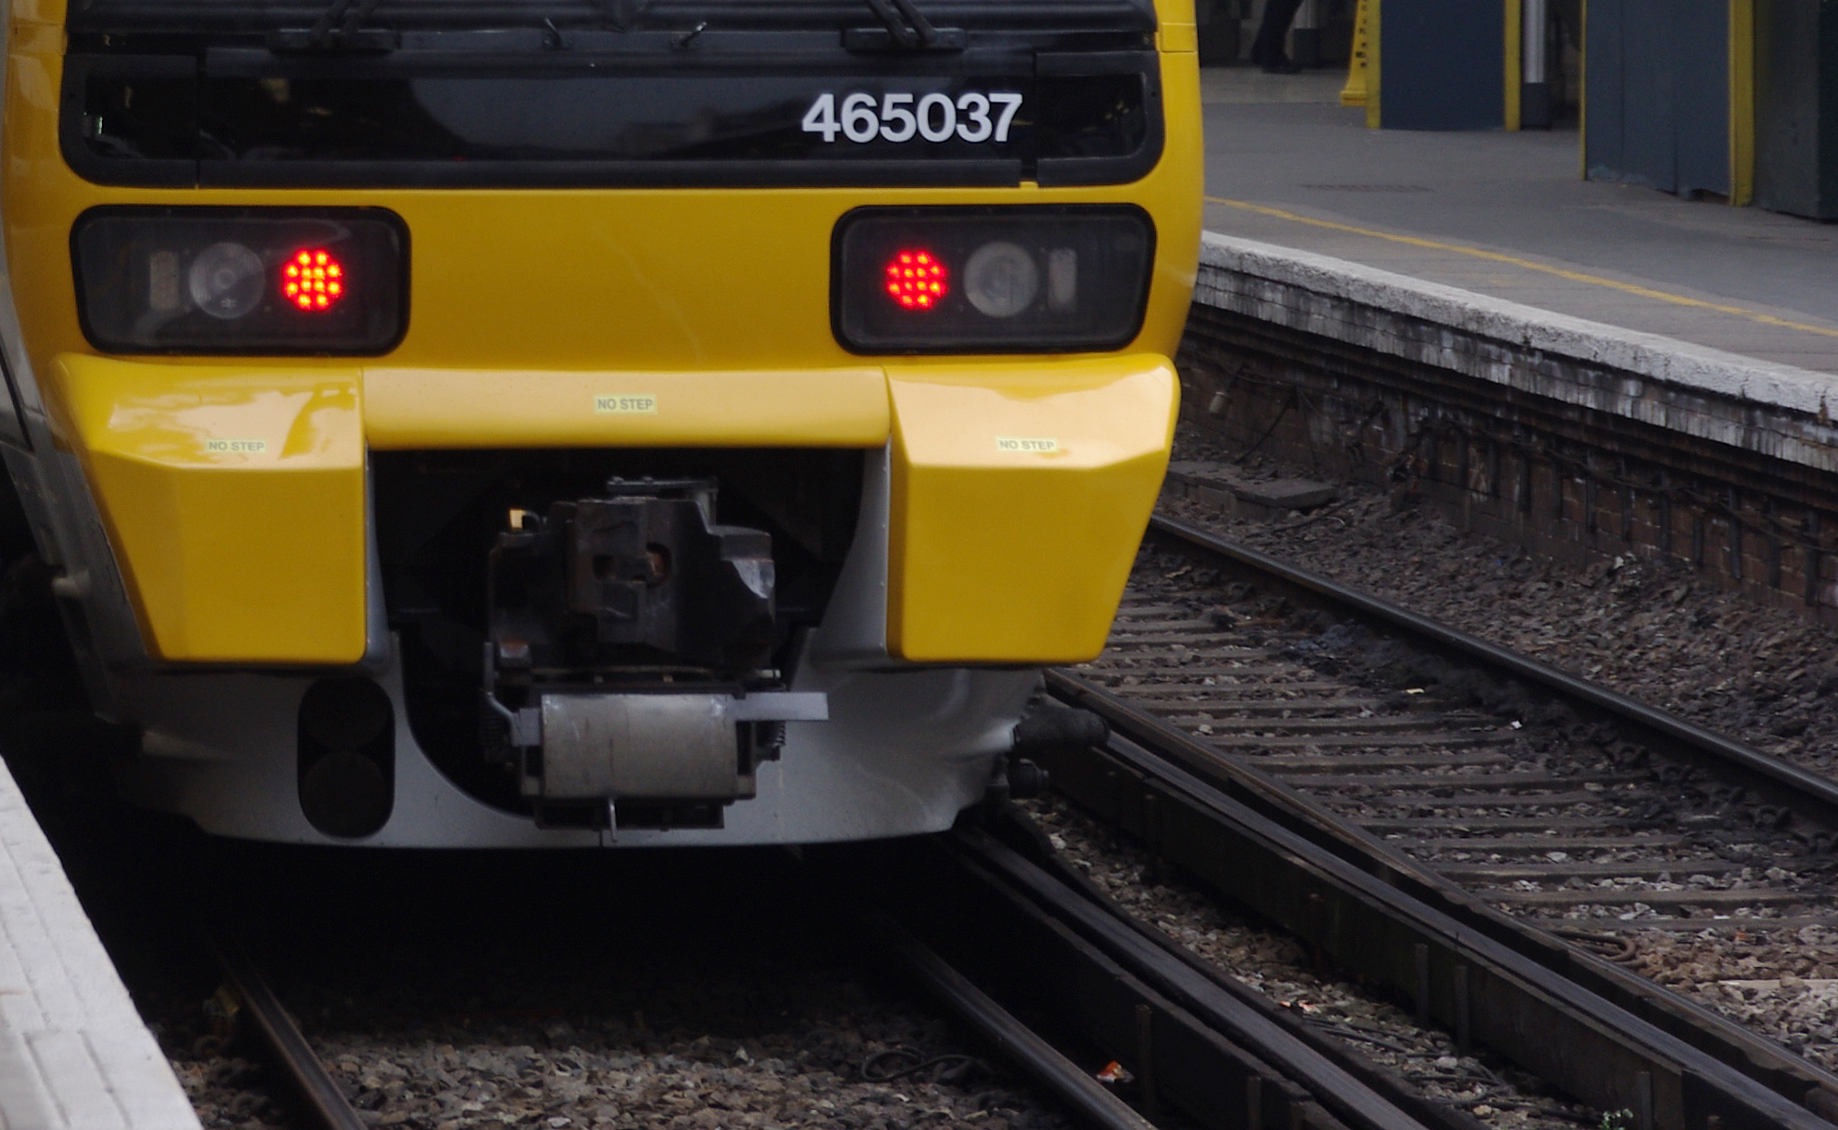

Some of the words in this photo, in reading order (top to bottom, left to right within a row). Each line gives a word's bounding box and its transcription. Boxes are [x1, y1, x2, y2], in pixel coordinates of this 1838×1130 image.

[802, 92, 1023, 143] 465037
[597, 398, 617, 410] NO
[620, 398, 653, 410] STEP
[208, 441, 228, 451] NO
[231, 441, 265, 451] STEP
[999, 439, 1019, 450] NO
[1021, 439, 1055, 451] STEP
